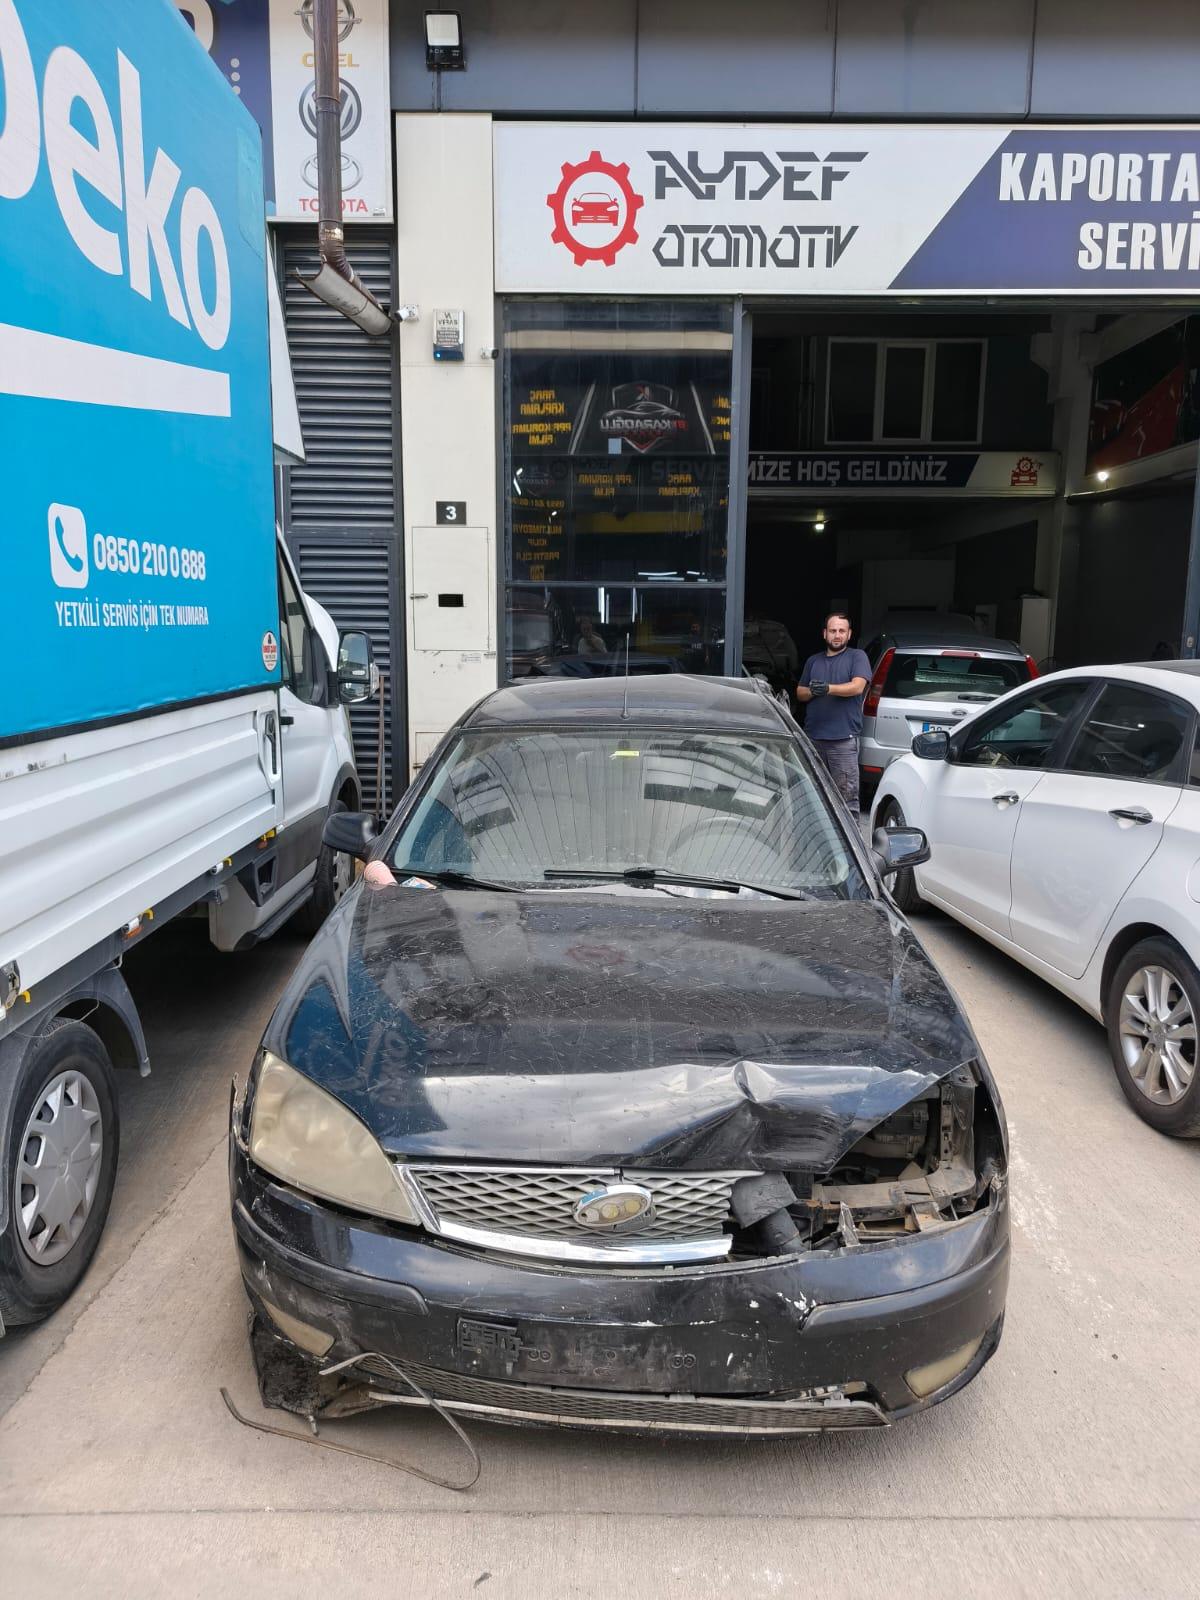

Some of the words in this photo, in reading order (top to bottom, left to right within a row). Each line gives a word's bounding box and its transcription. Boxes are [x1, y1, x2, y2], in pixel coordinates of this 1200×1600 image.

[302, 53, 360, 67] OEL
[646, 150, 870, 201] AYDEF
[999, 152, 1200, 202] KAPORTA
[299, 198, 368, 213] TOTA
[797, 461, 841, 486] HOŞ
[847, 456, 948, 481] GELDİNİZ
[446, 506, 457, 520] 3
[93, 533, 140, 574] 0850
[142, 541, 169, 577] 210
[169, 546, 180, 578] 0
[181, 548, 206, 581] 888
[55, 596, 100, 627] YETKİLİ
[102, 598, 139, 627] SERVİS
[140, 599, 159, 632] İÇİN
[159, 605, 176, 626] TEK
[176, 605, 209, 626] NUMARA
